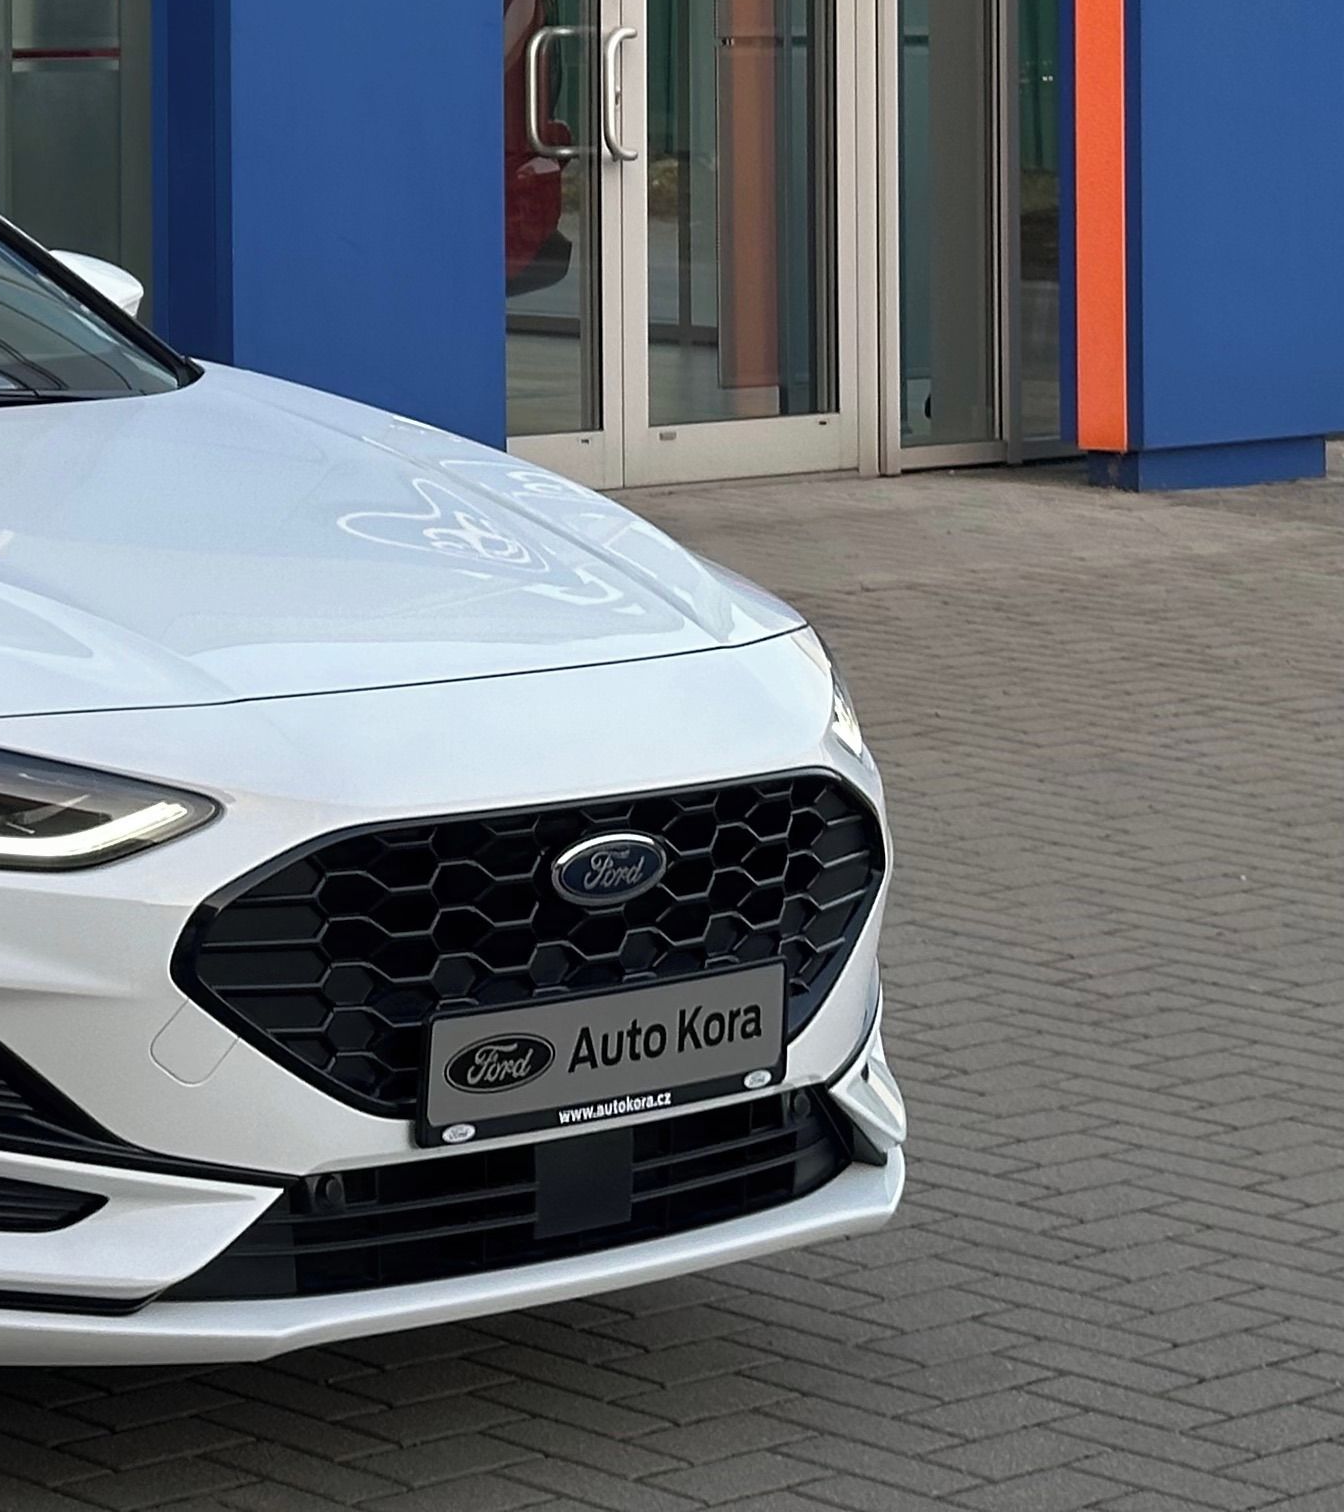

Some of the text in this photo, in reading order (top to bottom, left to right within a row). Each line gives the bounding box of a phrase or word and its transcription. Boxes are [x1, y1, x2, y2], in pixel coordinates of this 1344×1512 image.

[583, 847, 644, 887] Ford
[567, 1003, 763, 1073] Auto Kora
[466, 1043, 532, 1085] Ford
[558, 1092, 672, 1124] www.autokora.cz
